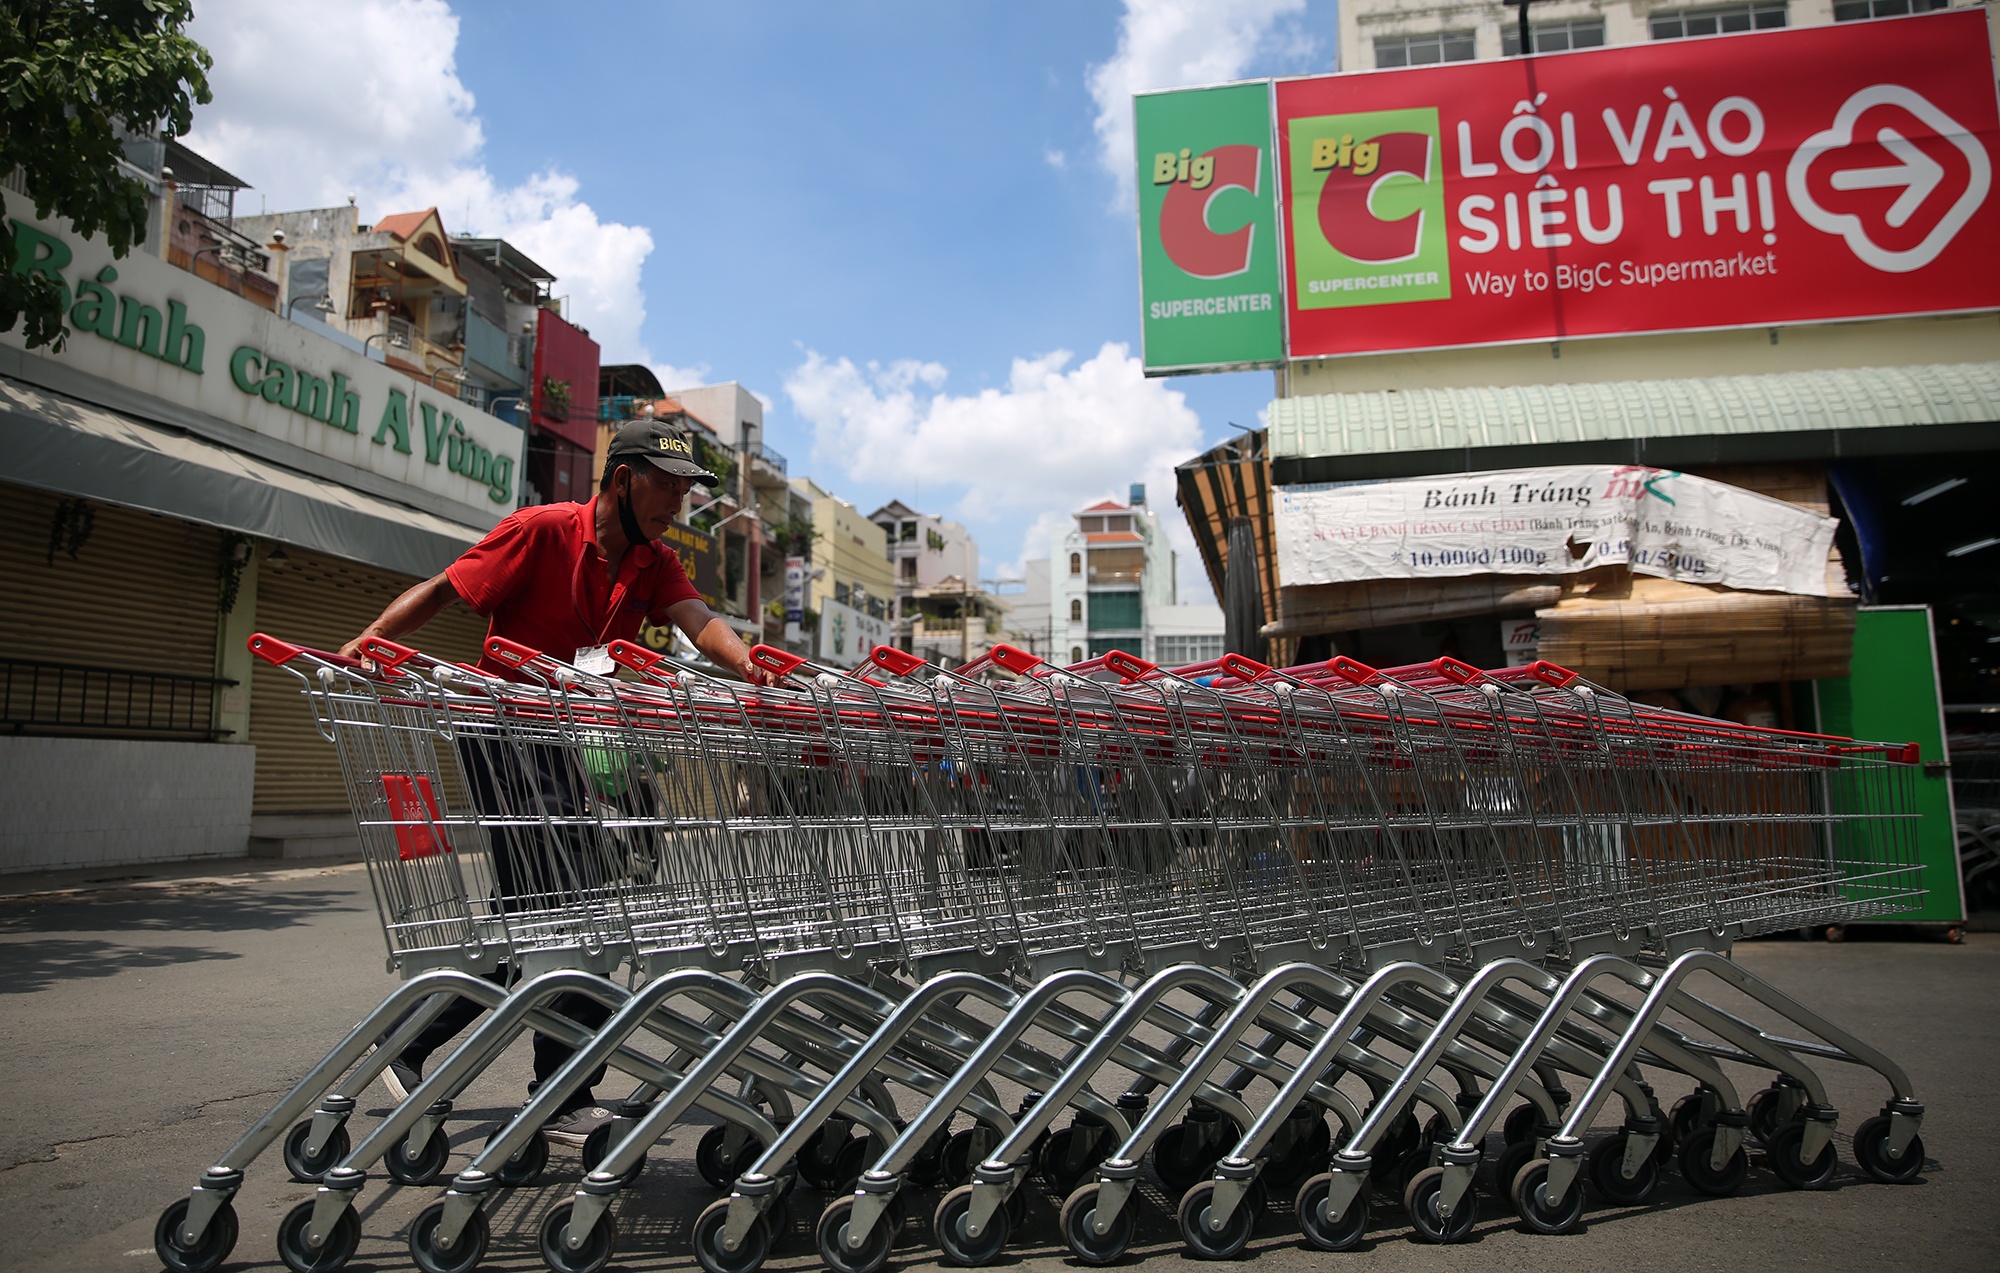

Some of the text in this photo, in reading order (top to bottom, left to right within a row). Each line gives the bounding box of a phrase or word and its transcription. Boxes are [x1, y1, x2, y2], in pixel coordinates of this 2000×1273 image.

[1457, 86, 1765, 178] LỐI VÀO
[1153, 144, 1262, 280] Big C
[1312, 132, 1433, 265] Big C
[1457, 170, 1777, 254] SIÊU THỊ
[1150, 293, 1273, 319] SUPERCENTER
[1308, 271, 1440, 293] SUPERCENTER
[1465, 251, 1777, 297] Way to BigC Supermarket
[9, 218, 515, 504] Bánh canh A Vùng
[1423, 482, 1592, 508] Bánh Tráng
